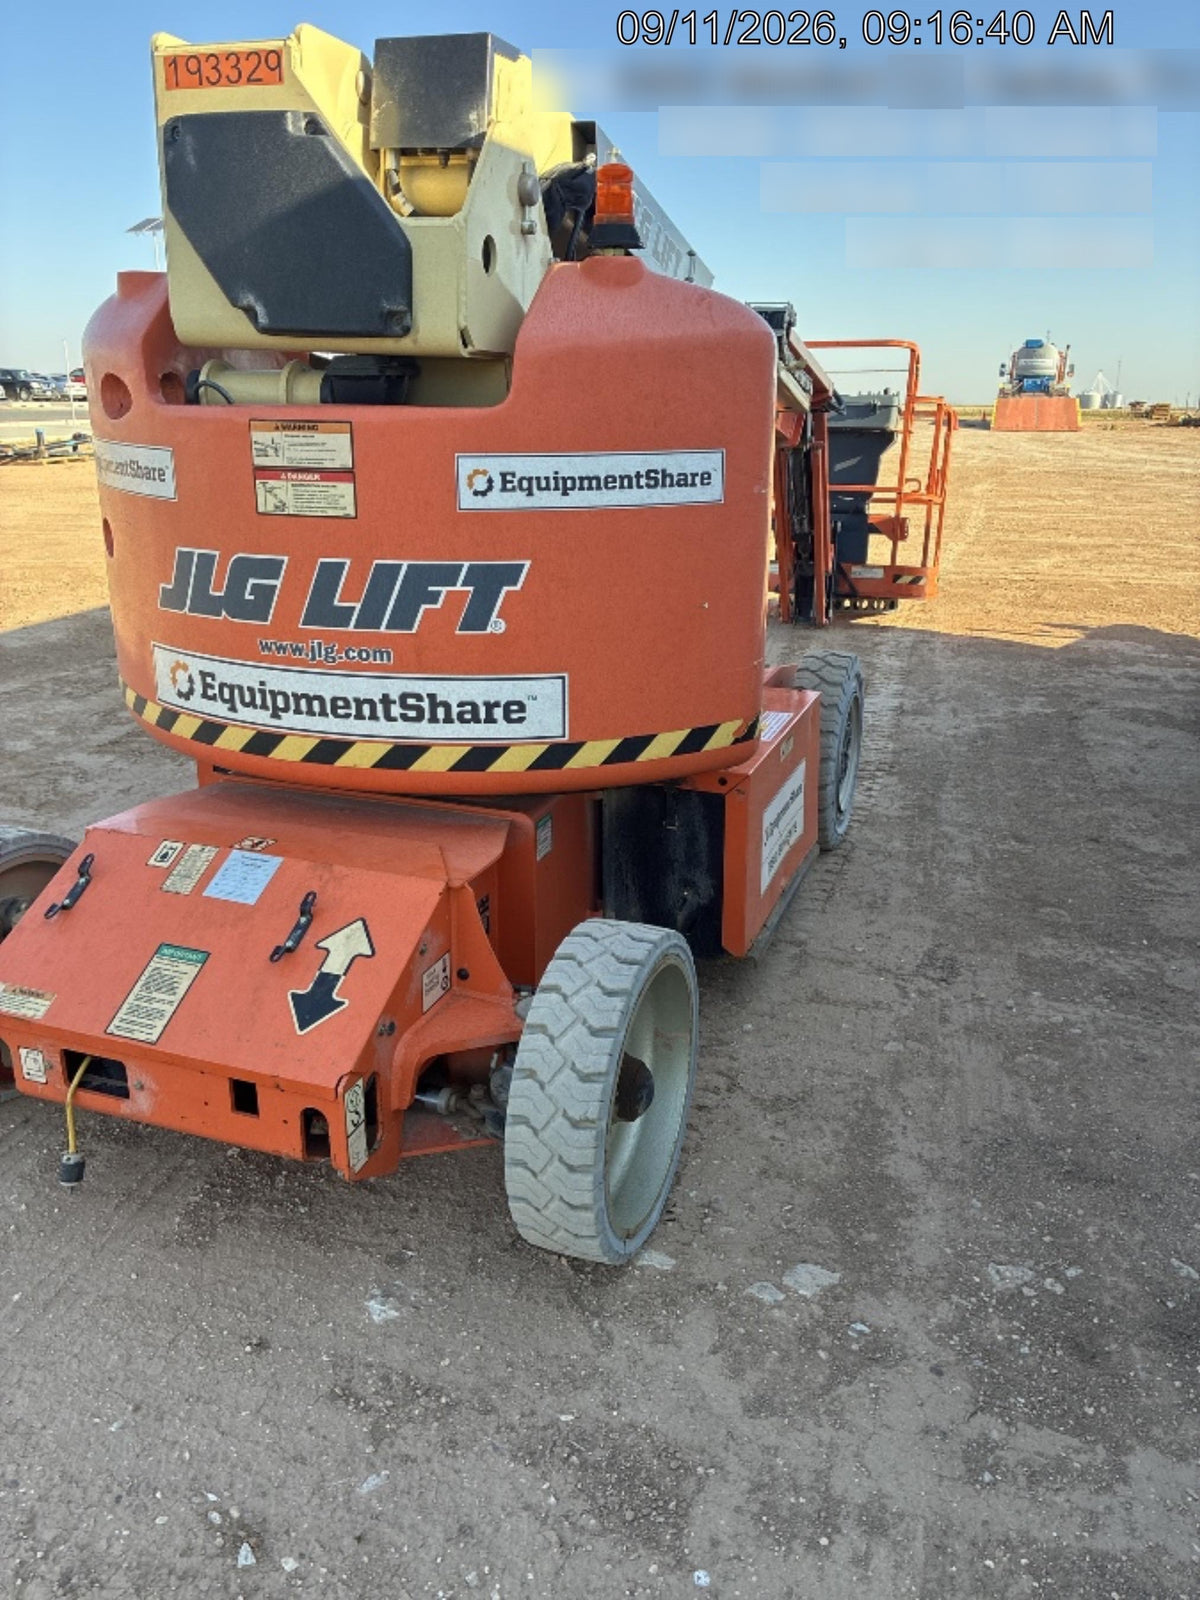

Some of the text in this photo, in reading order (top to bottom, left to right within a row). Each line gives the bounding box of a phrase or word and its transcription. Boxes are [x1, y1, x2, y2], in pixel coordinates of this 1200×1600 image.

[168, 50, 282, 87] 193329
[499, 468, 712, 496] EquipmentShare
[158, 547, 531, 633] JLG LIFT
[258, 638, 394, 664] www.jlg.com
[199, 670, 527, 725] EquipmentShare
